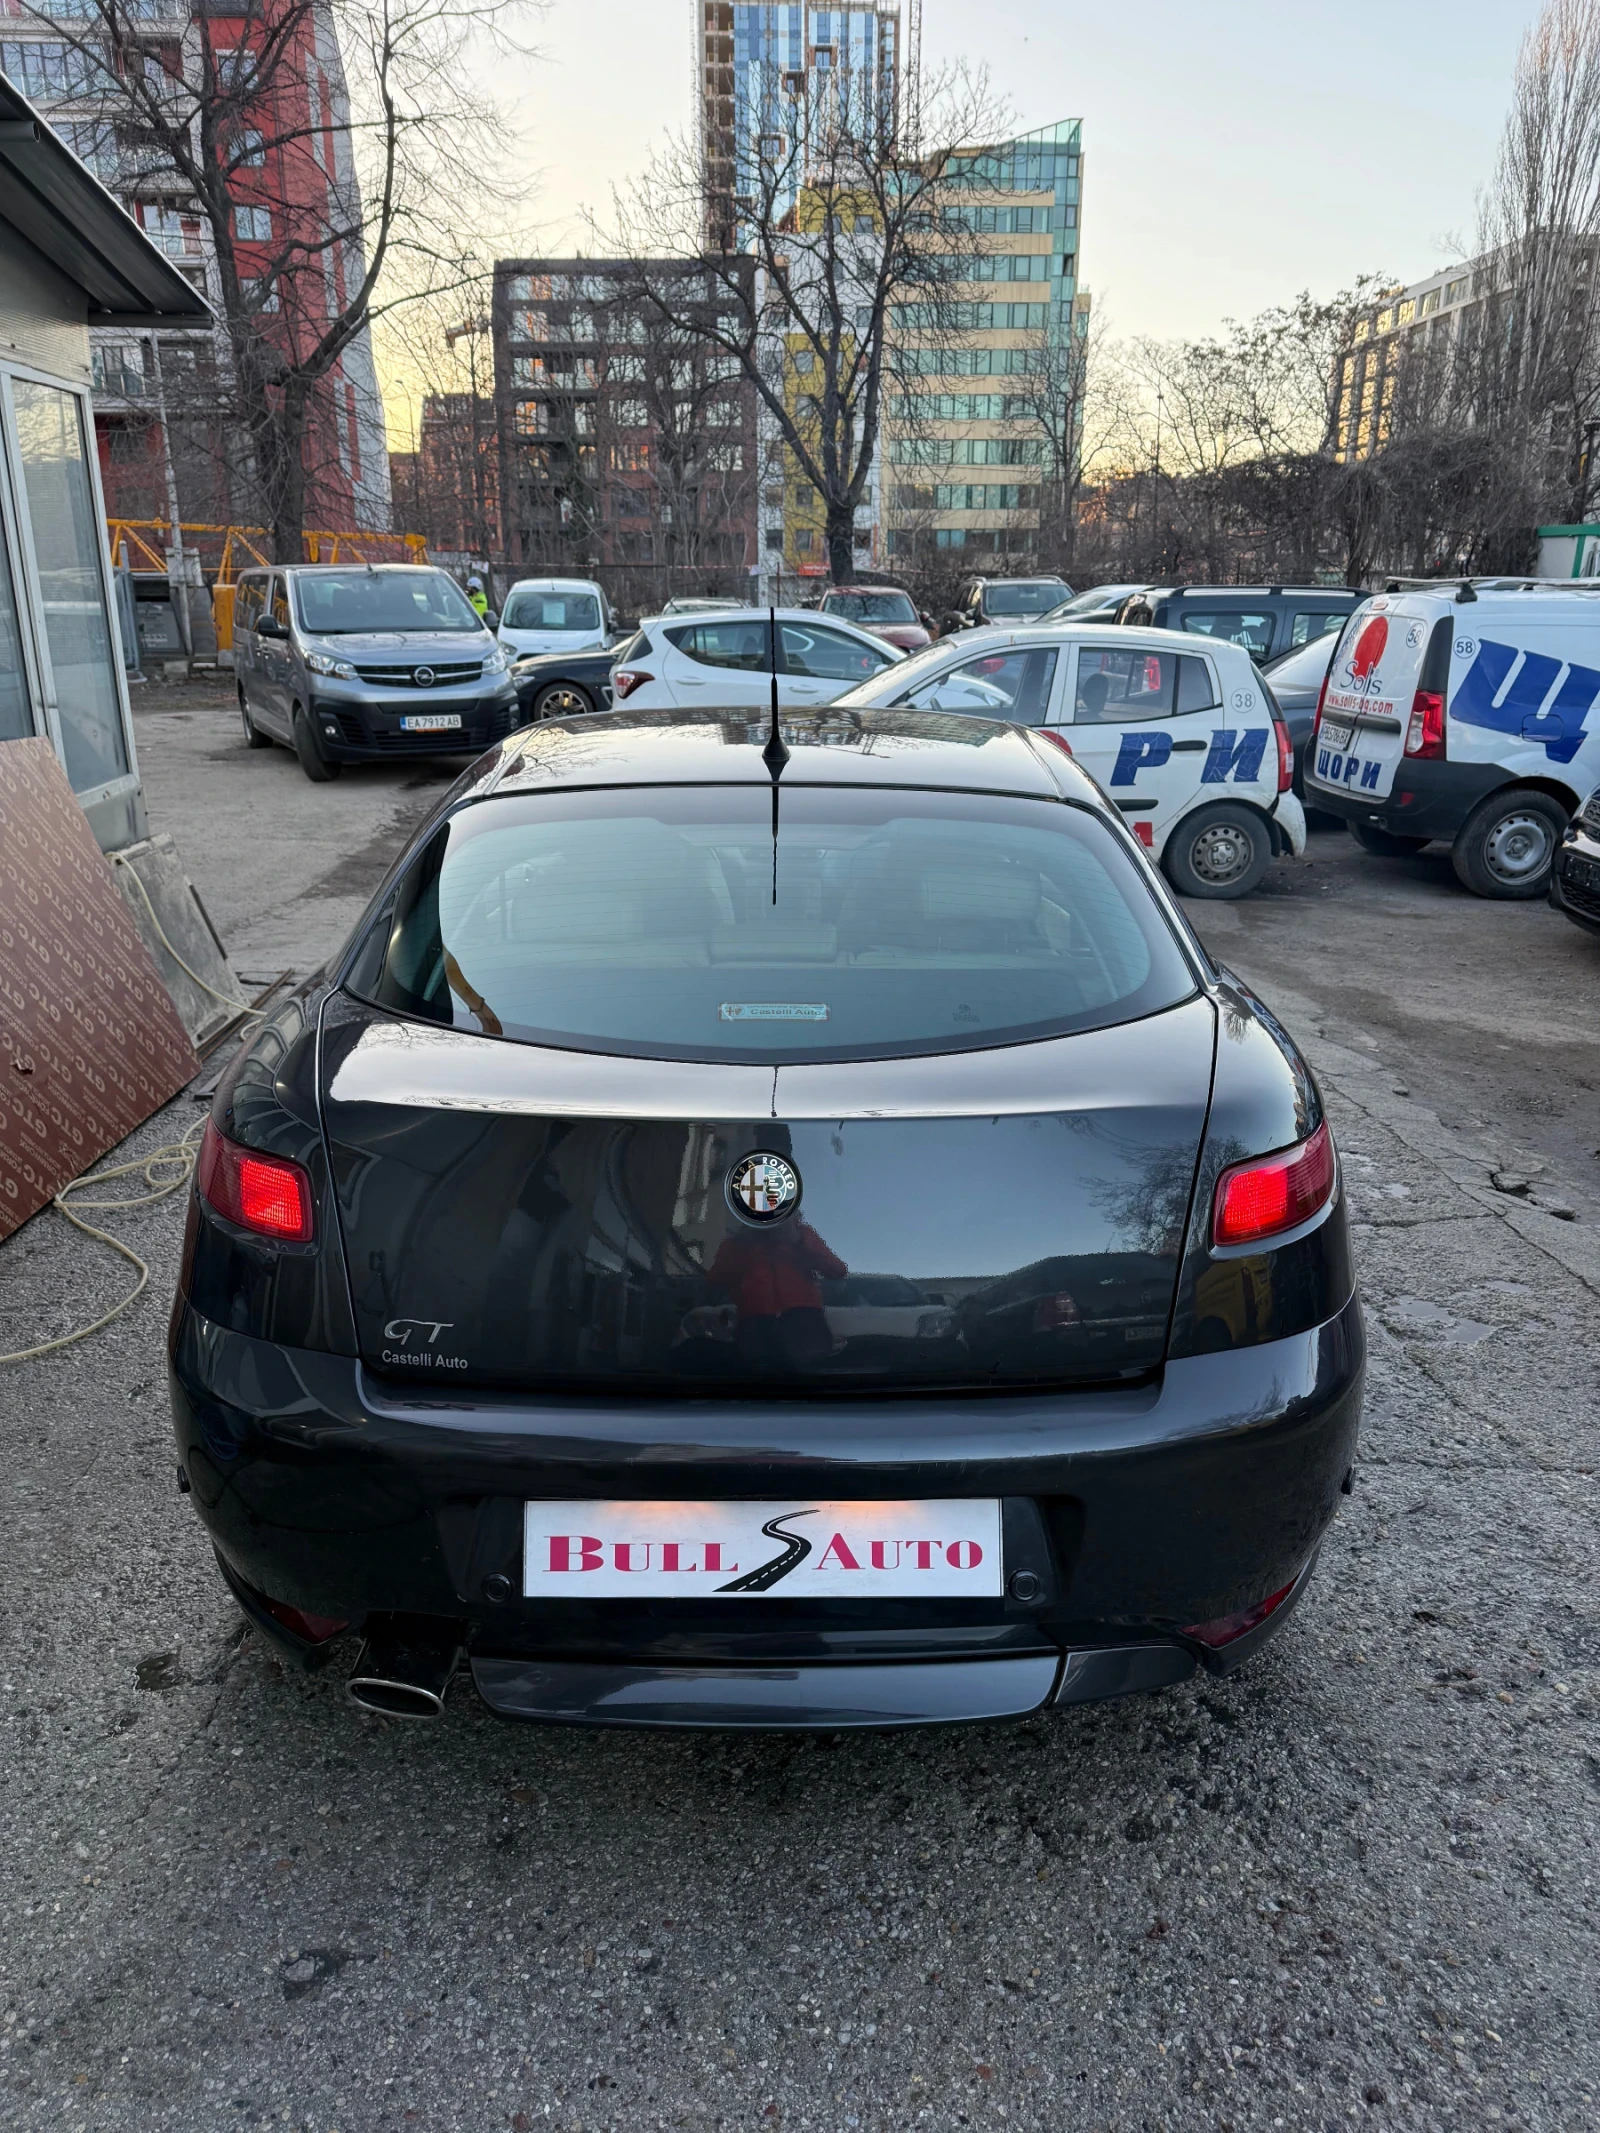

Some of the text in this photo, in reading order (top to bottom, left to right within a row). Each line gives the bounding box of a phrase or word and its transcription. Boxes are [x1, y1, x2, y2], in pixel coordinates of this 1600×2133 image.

[1407, 625, 1422, 644] 58
[1456, 642, 1473, 654] 58
[1340, 661, 1382, 696] Solis
[1235, 694, 1253, 708] 38
[1328, 694, 1394, 715] www.solis-bg.com
[1317, 748, 1382, 790] ЩОРИ
[20, 772, 50, 812] GTC
[53, 792, 81, 831] GTC
[31, 826, 61, 866] GTC
[64, 845, 92, 882] GTC
[6, 863, 37, 904] GTC
[95, 862, 121, 899] GTC
[42, 882, 71, 921] GTC
[75, 898, 103, 936] GTC
[18, 922, 49, 963] GTC
[106, 914, 132, 949] GTC
[53, 938, 82, 976] GTC
[86, 953, 113, 989] GTC
[28, 982, 60, 1021] GTC
[116, 966, 143, 1001] GTC
[145, 979, 170, 1012] GTC
[64, 996, 93, 1033] GTC
[97, 1008, 124, 1044] GTC
[795, 1008, 820, 1016] Auto
[36, 1018, 73, 1061] FORMWORK
[127, 1019, 154, 1054] GTC
[156, 1031, 181, 1063] GTC
[39, 1044, 71, 1082] GTC
[75, 1055, 105, 1092] GTC
[108, 1065, 136, 1100] GTC
[12, 1097, 46, 1137] GTC
[51, 1106, 82, 1145] GTC
[19, 1135, 63, 1179] FORMWORK
[732, 1157, 795, 1190] ALFA ROMEO
[384, 1319, 454, 1345] GT
[382, 1349, 469, 1369] Castelli Auto
[542, 1532, 984, 1572] BULL AUTO
